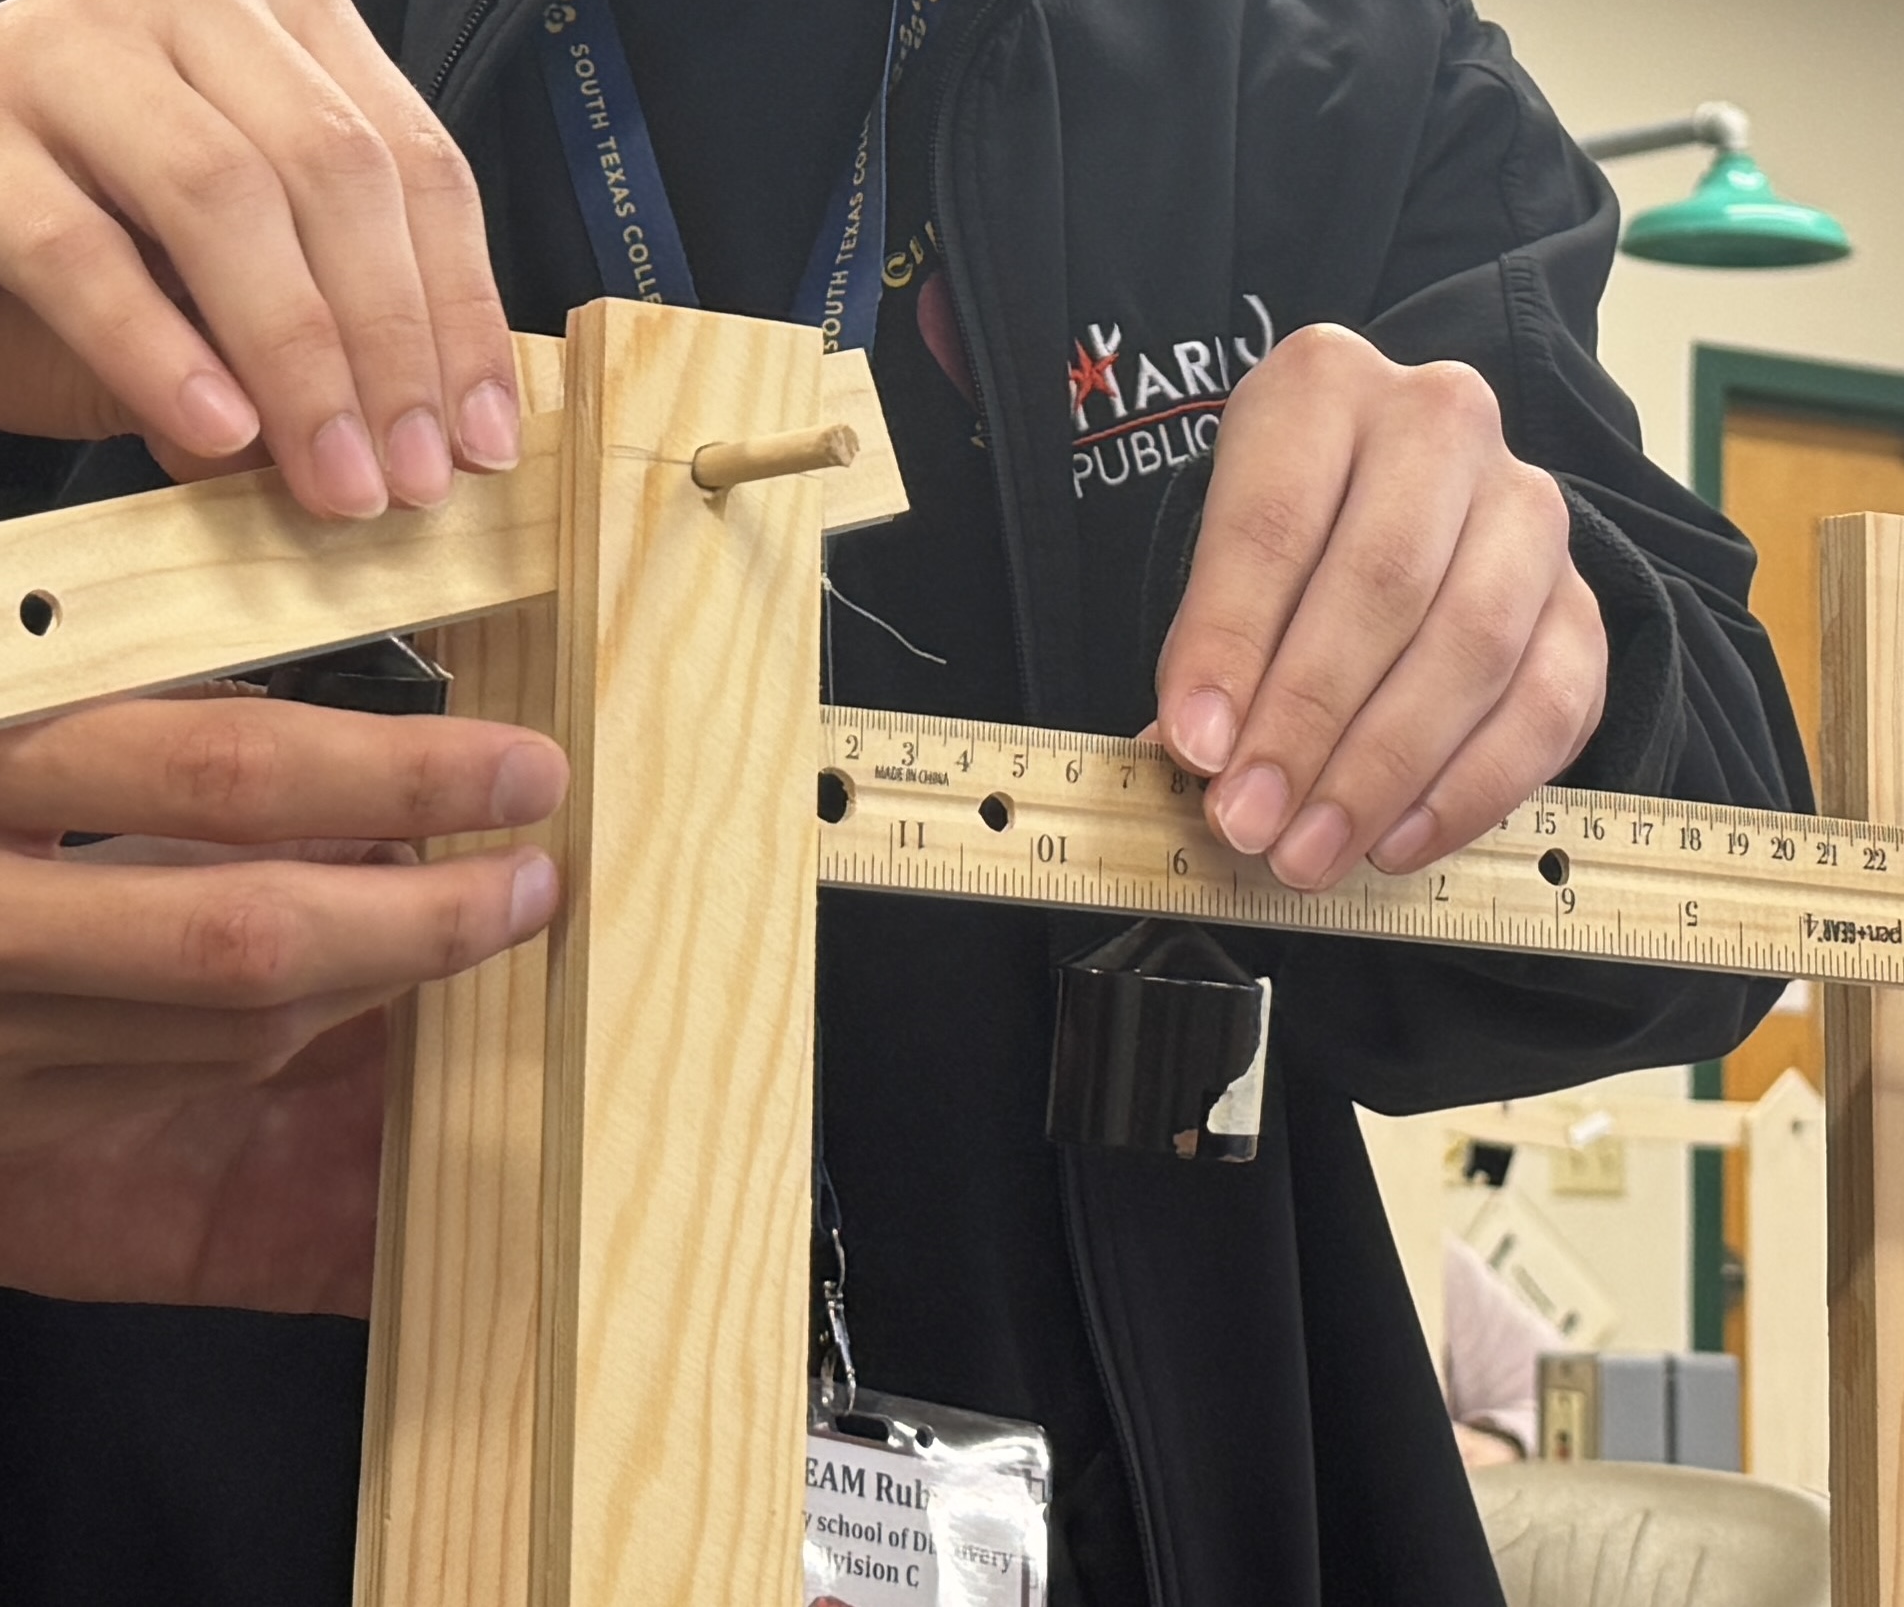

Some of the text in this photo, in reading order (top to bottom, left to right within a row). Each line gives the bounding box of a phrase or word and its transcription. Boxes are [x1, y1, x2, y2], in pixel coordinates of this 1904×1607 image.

[570, 44, 663, 304] SOUTH TEXAS COLLE
[835, 192, 864, 265] TEXAS
[822, 269, 849, 353] SOUTH
[845, 734, 1185, 794] 2 3 4 5 6 7 8
[874, 765, 903, 782] MADE
[905, 766, 917, 782] IN
[1534, 811, 1557, 835] 15
[1582, 816, 1605, 841] 16
[1631, 821, 1654, 846] 17
[1679, 827, 1702, 851] 18
[1727, 832, 1749, 856] 19
[1770, 837, 1795, 861] 20
[1816, 842, 1838, 866] 21
[1863, 847, 1887, 871] 22
[898, 820, 925, 850] 11
[1037, 834, 1068, 864] 10
[1434, 874, 1449, 901] 7
[1685, 900, 1699, 927] 5
[1803, 912, 1819, 939] 4
[806, 1457, 930, 1511] EAM Rub
[816, 1513, 882, 1544] school
[888, 1527, 909, 1550] of
[825, 1545, 920, 1589] ivision C
